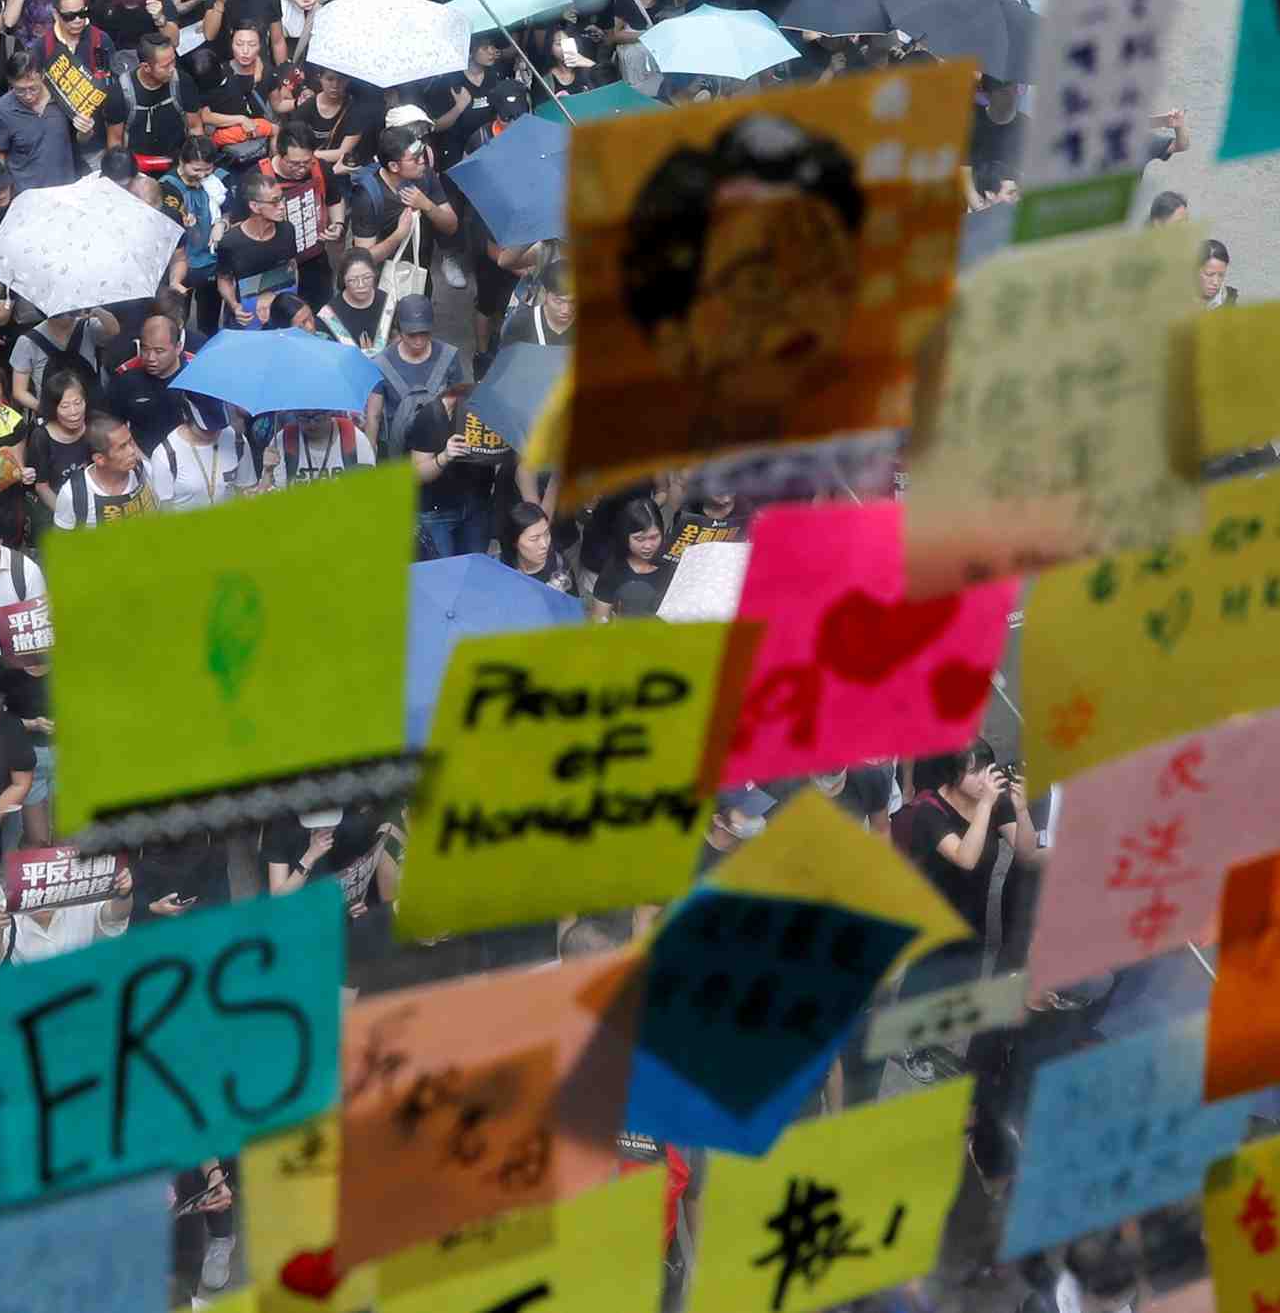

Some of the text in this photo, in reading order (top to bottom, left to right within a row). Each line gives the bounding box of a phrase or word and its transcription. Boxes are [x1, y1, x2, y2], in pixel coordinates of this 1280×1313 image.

[21, 854, 116, 888] 平反暴動
[621, 1139, 658, 1152] TO CHINA
